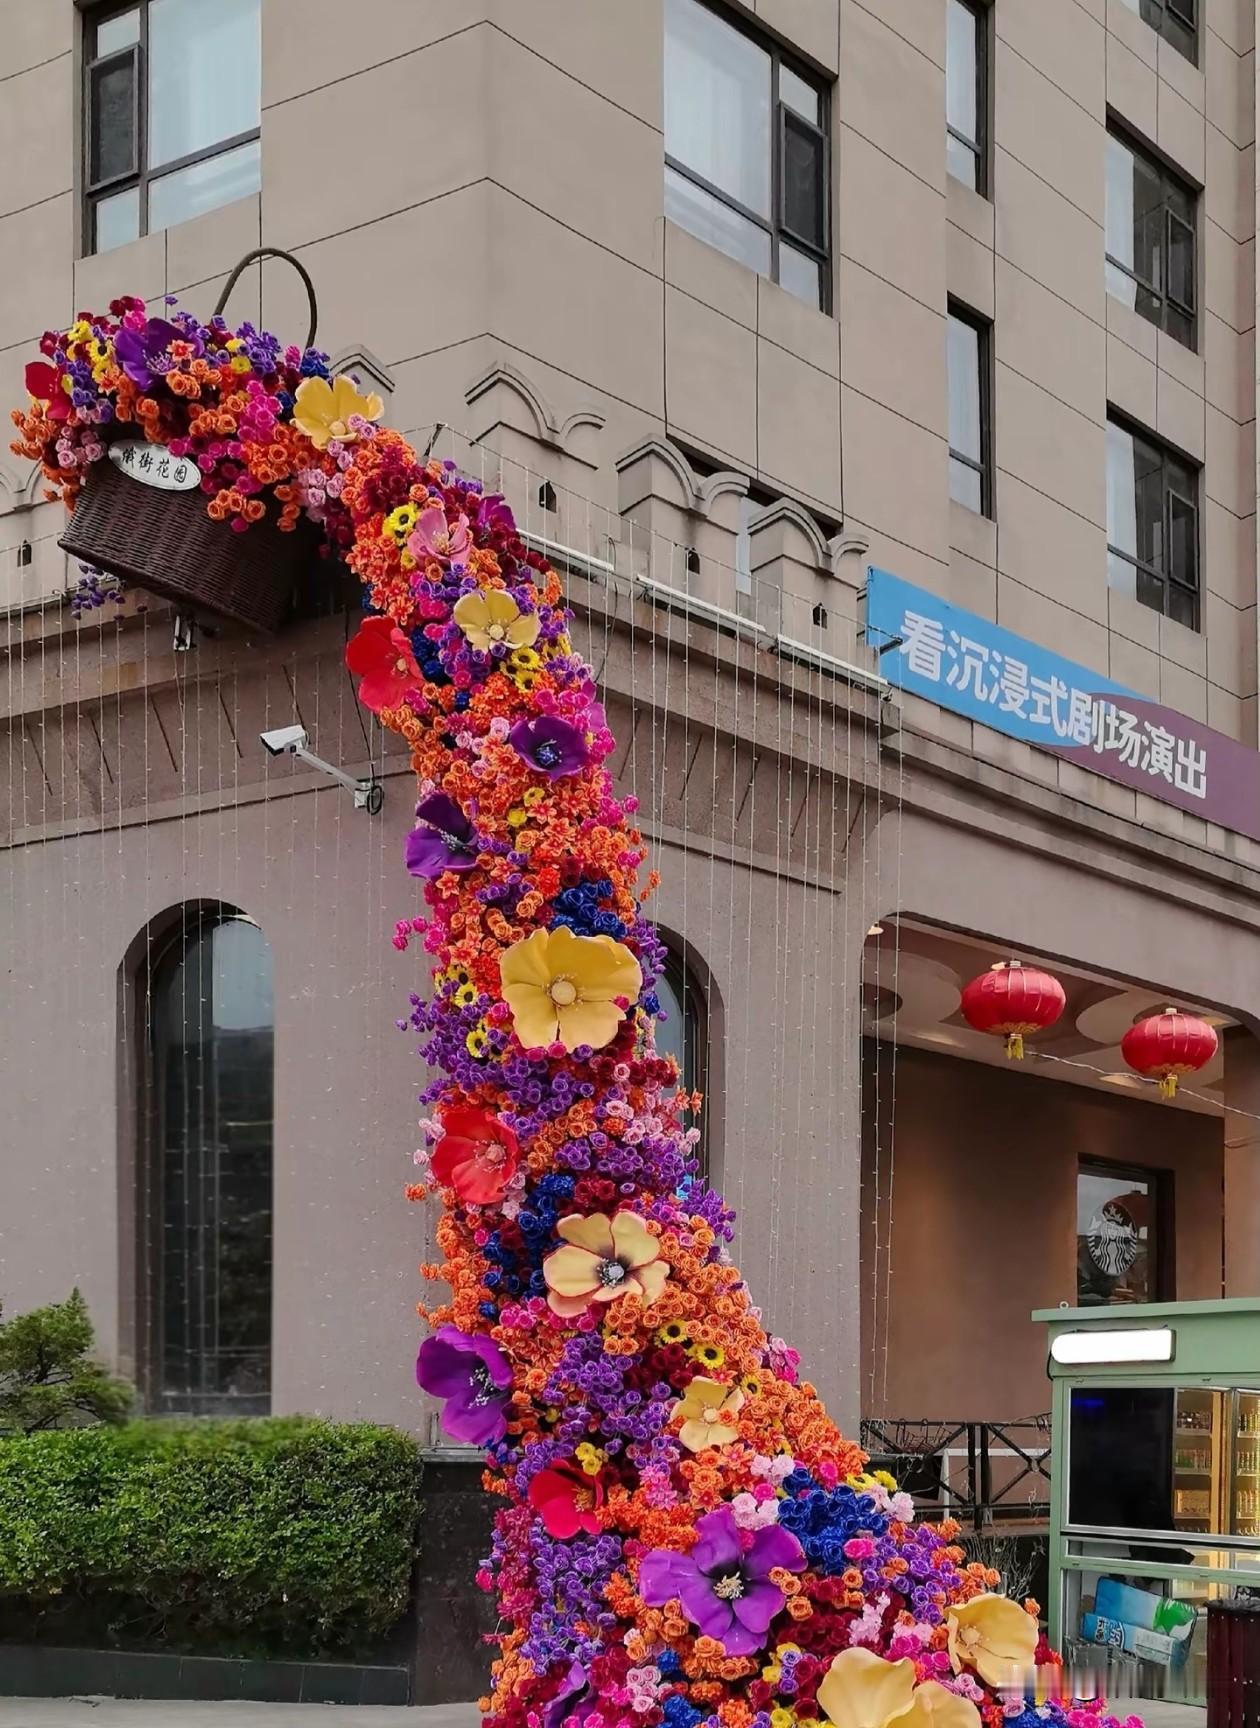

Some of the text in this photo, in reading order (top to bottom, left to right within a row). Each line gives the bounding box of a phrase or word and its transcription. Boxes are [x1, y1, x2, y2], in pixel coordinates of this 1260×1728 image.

[900, 610, 1207, 799] 看沉浸式剧场演出
